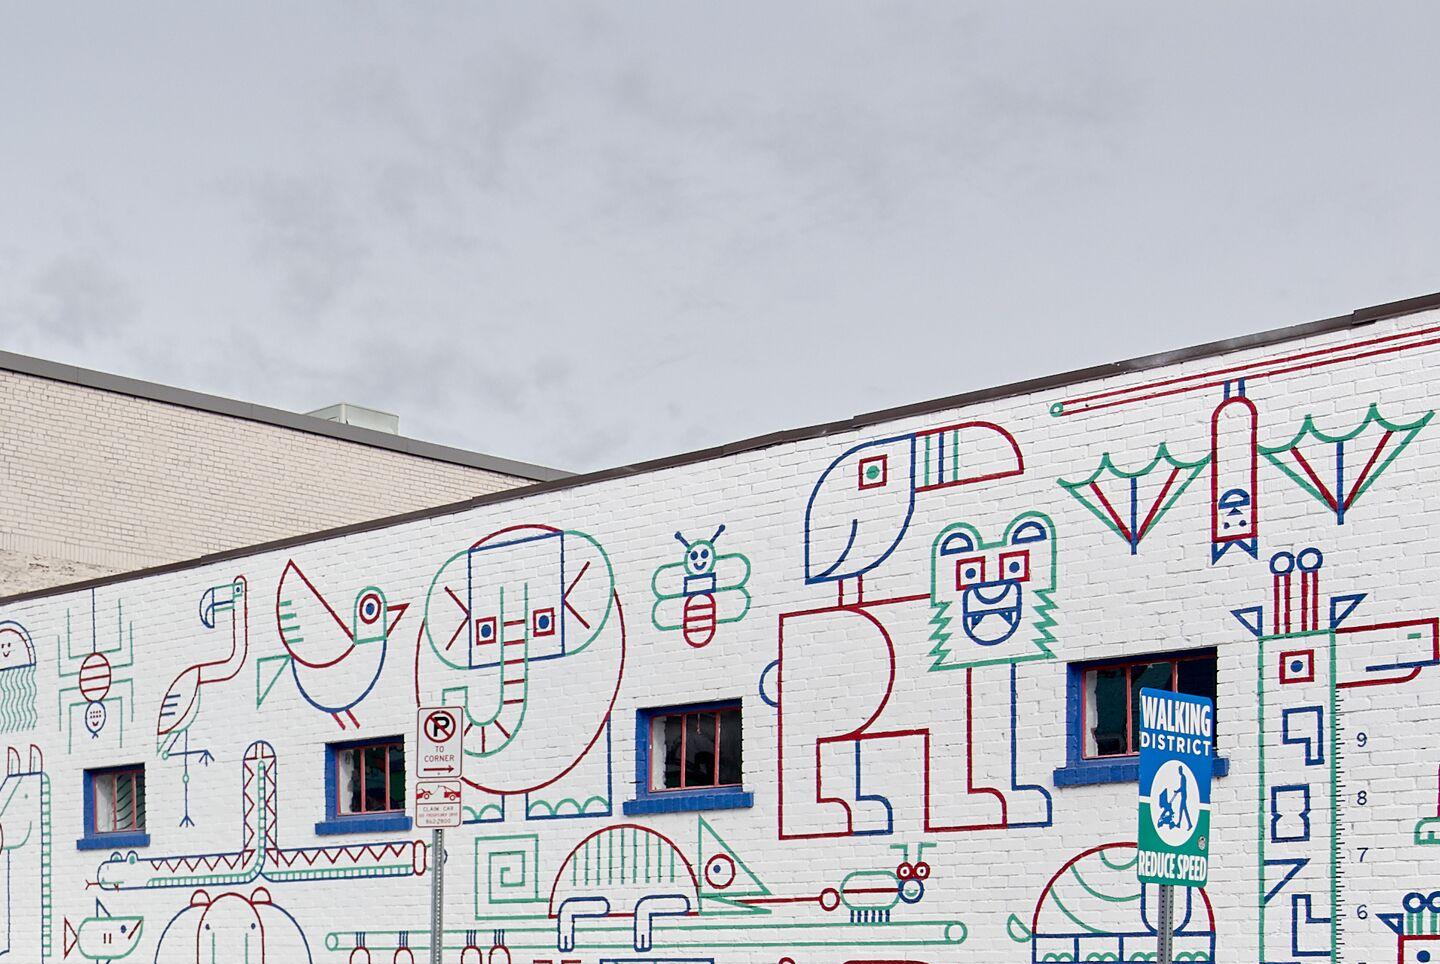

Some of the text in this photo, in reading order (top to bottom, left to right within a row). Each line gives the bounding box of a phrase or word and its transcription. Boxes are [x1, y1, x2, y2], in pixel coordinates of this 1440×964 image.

[1141, 695, 1211, 737] WALKING
[1140, 731, 1211, 756] DISTRICT
[1356, 732, 1368, 748] 9
[435, 745, 445, 753] TO
[423, 754, 455, 763] CORNER
[1356, 790, 1368, 806] 8
[1356, 847, 1369, 862] 7
[1138, 850, 1207, 881] REDUCE SPEED
[1356, 904, 1368, 920] 6
